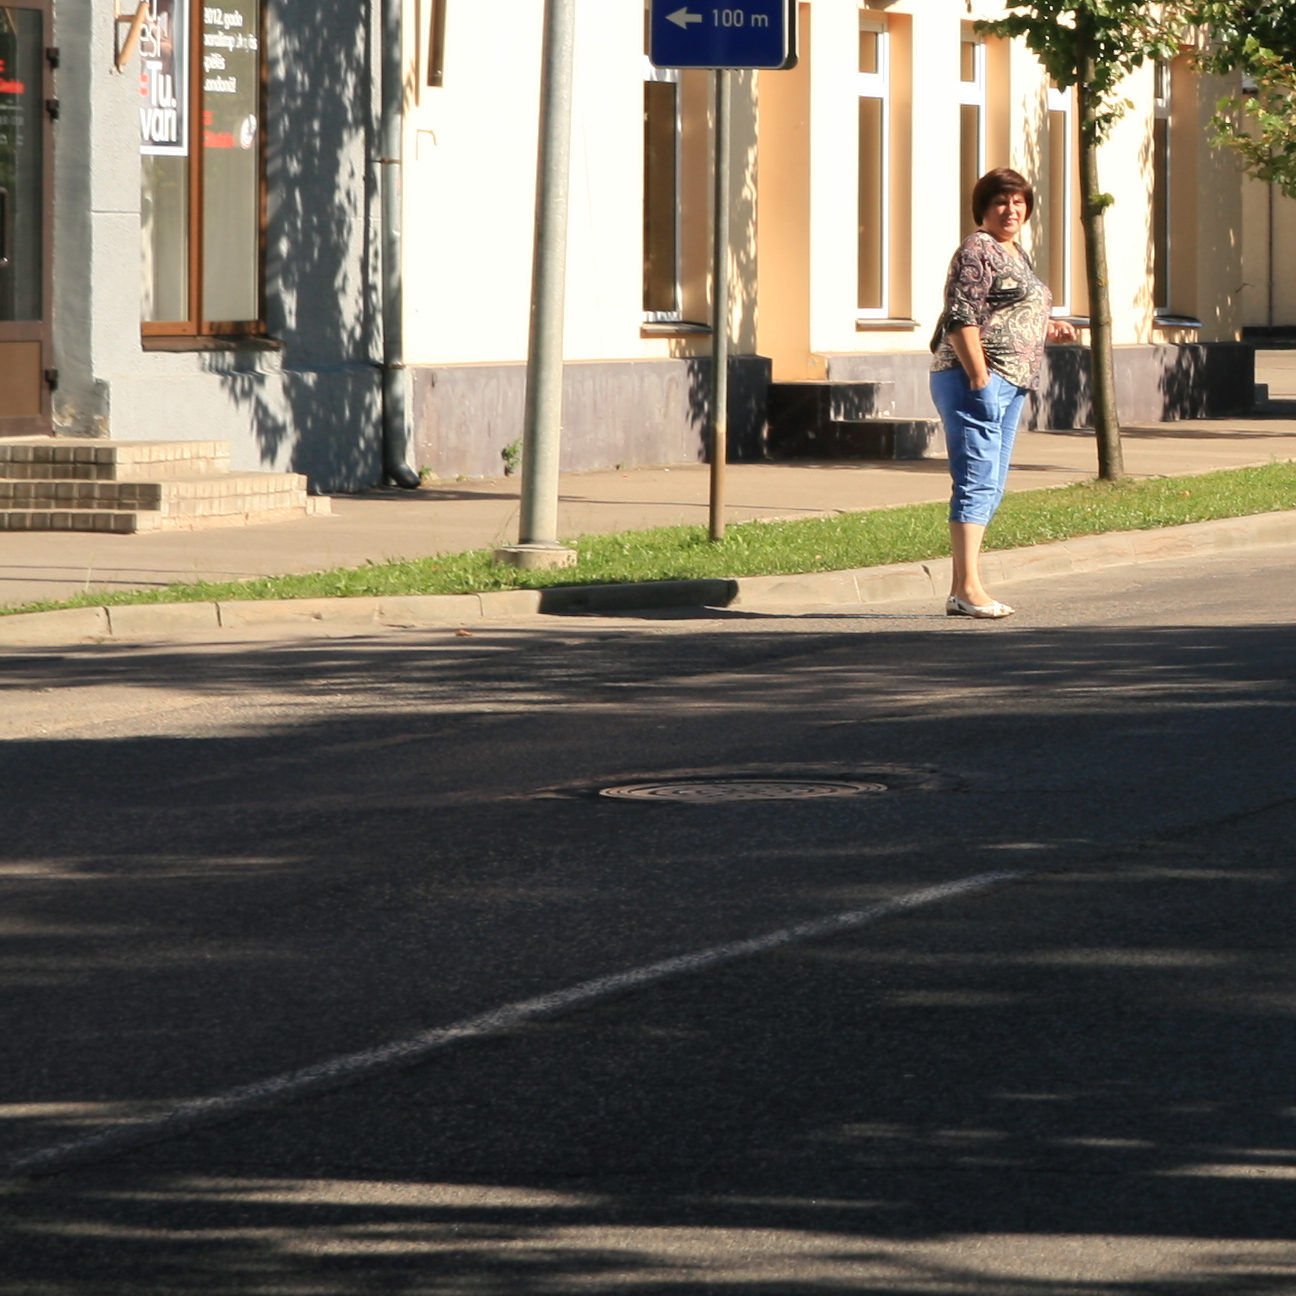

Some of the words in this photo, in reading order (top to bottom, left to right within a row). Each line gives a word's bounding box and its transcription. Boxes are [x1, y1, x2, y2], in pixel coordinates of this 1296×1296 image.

[712, 9, 744, 27] 100
[751, 13, 769, 27] m
[146, 60, 177, 108] Tu.
